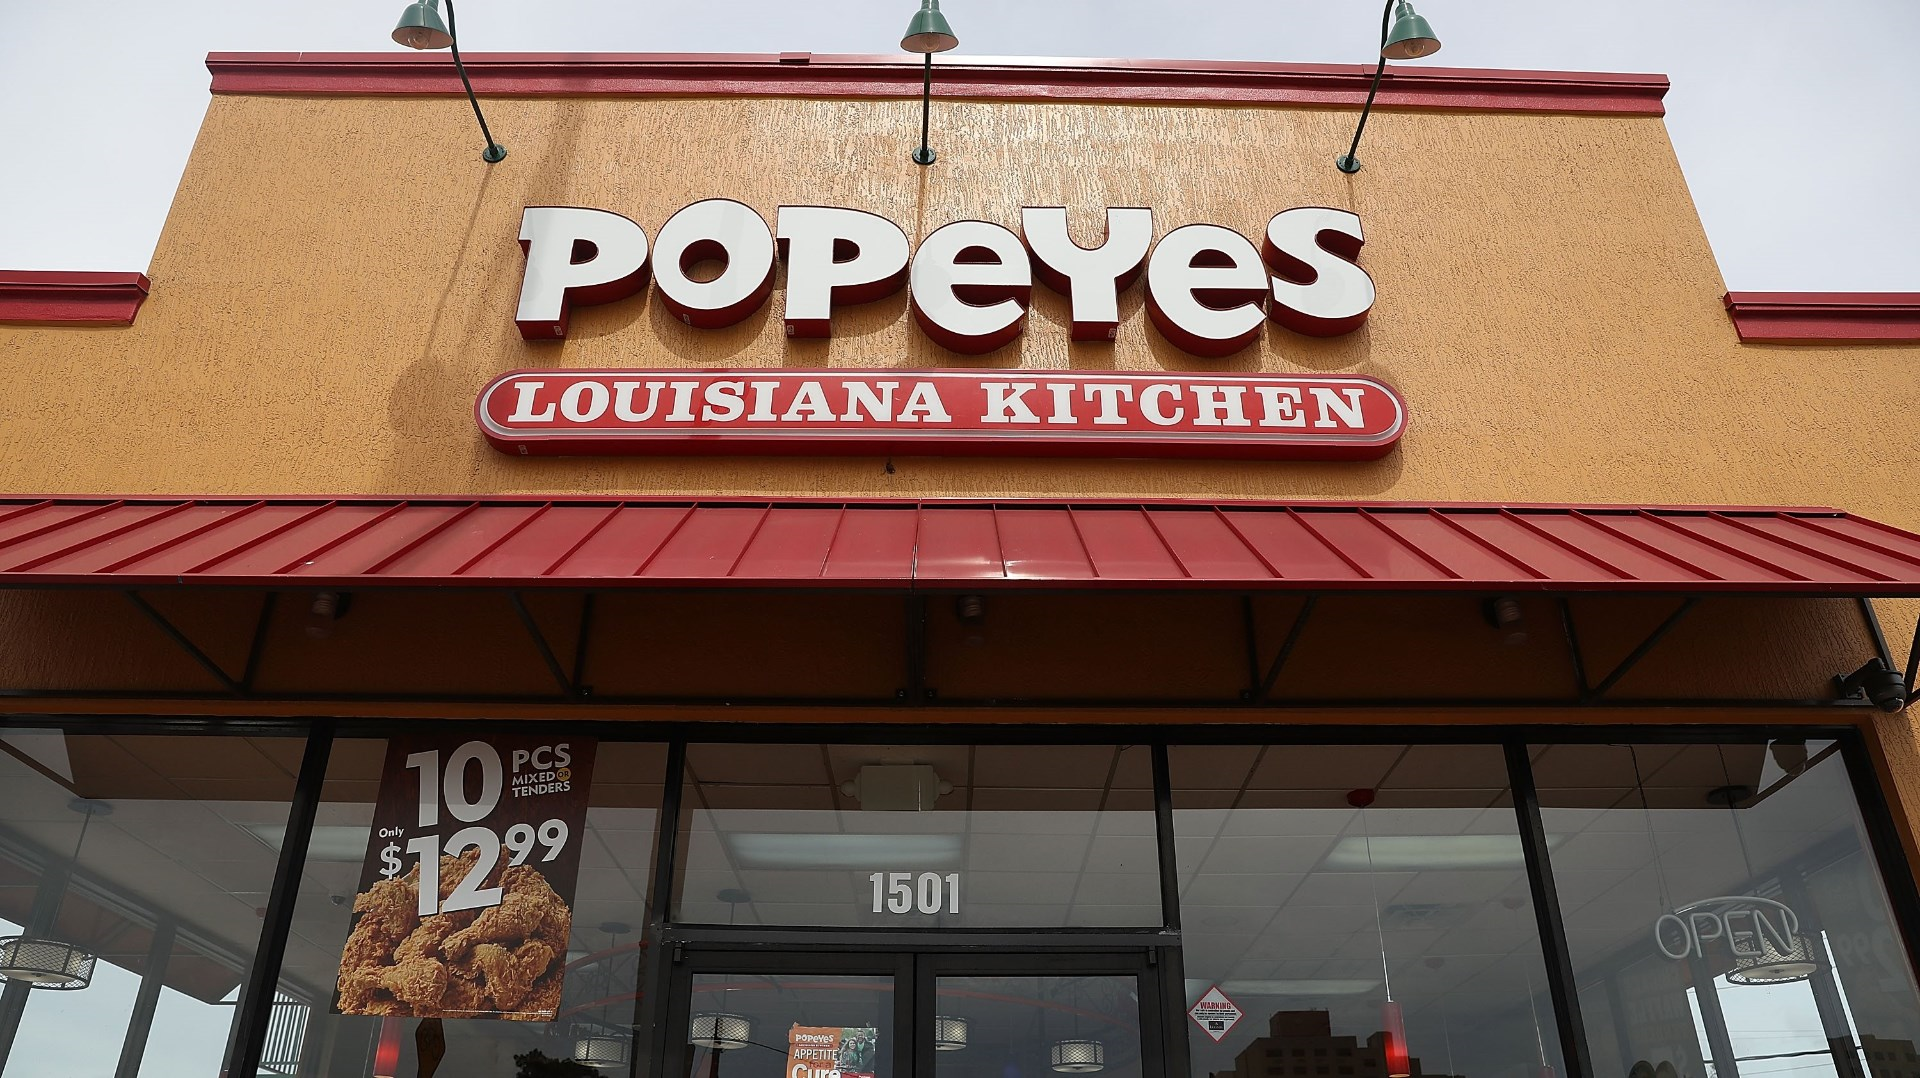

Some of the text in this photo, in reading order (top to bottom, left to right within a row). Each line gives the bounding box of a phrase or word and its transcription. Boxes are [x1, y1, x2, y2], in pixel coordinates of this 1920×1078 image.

[507, 380, 1366, 429] LOUISIANA KITCHEN
[512, 743, 571, 773] PCS
[406, 740, 503, 828] 10
[512, 770, 570, 786] MIXED OR
[512, 780, 571, 798] TENDERS
[378, 827, 405, 838] Only
[869, 872, 959, 915] 1501
[1655, 909, 1795, 960] OPEN
[793, 1048, 838, 1060] APPETITE
[809, 1060, 822, 1068] for
